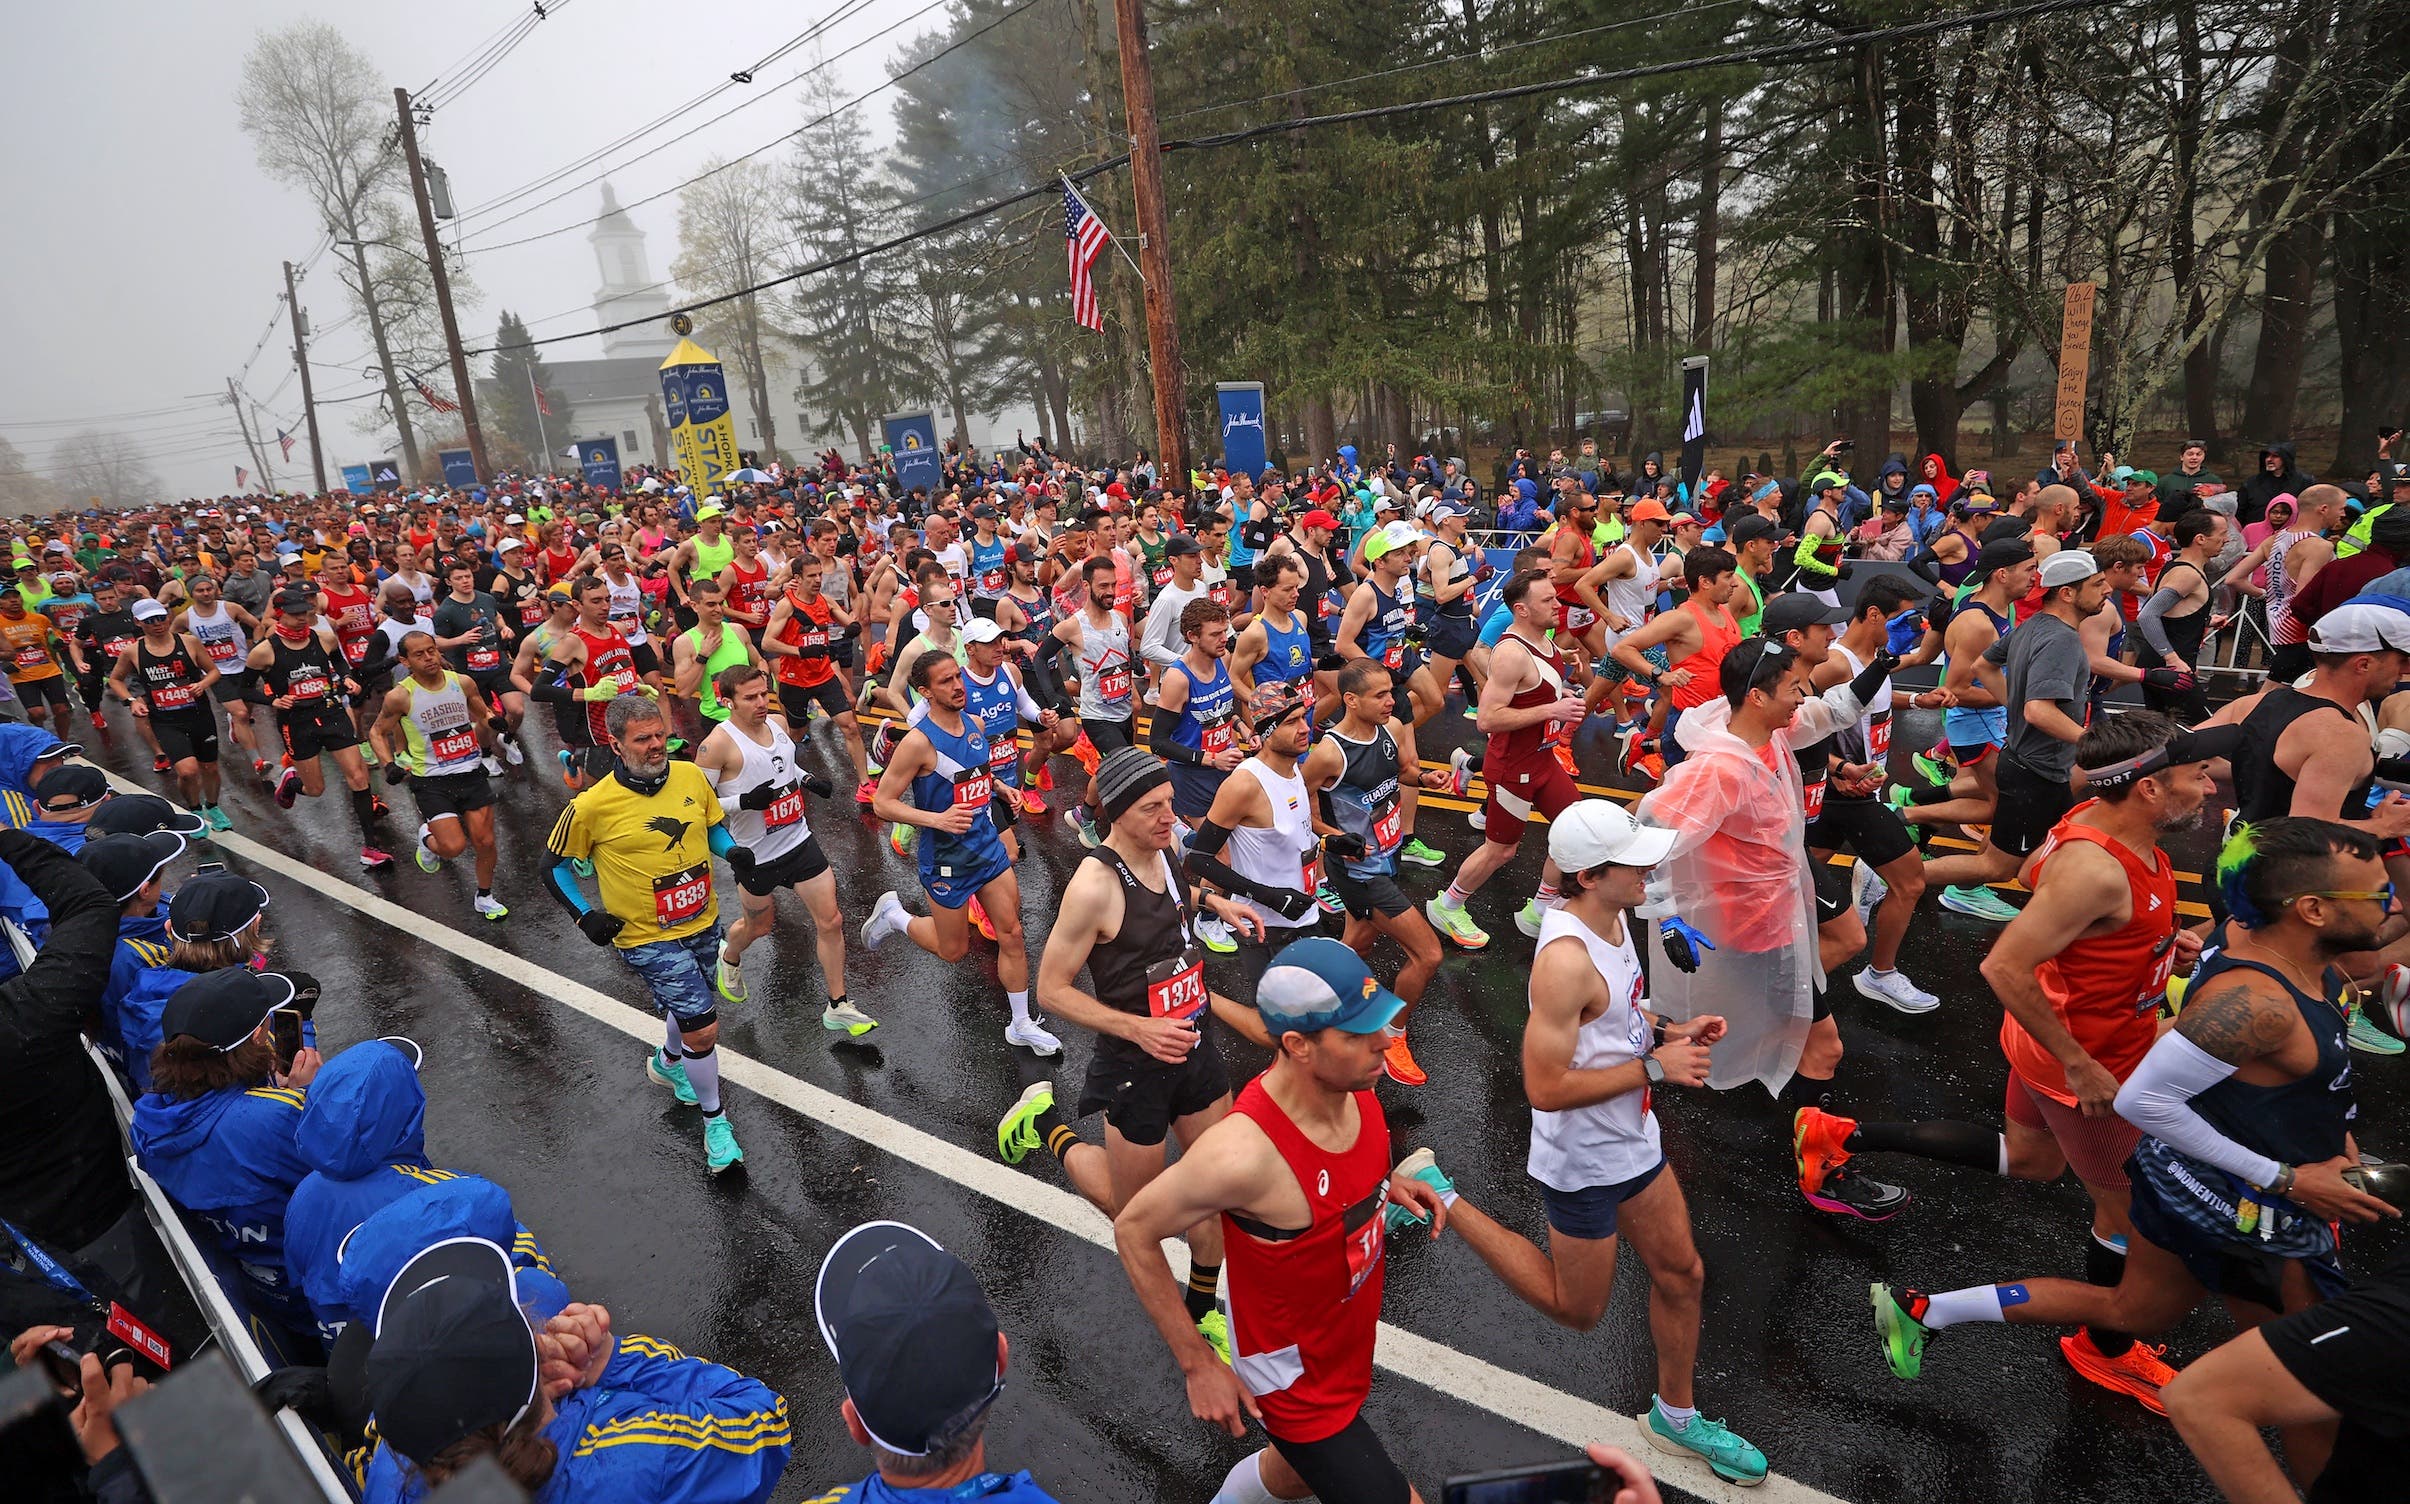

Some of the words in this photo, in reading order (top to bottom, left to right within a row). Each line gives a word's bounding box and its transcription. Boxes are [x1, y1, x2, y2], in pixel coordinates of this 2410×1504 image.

[2068, 285, 2092, 303] 26.2
[2067, 303, 2085, 316] will
[2062, 361, 2083, 381] Enjoy
[2063, 381, 2078, 393] the
[145, 664, 170, 676] WEST
[148, 670, 176, 682] VALLEY
[980, 701, 1012, 720] Agos
[430, 713, 465, 730] STRIDERS
[437, 734, 474, 755] 1649
[1206, 727, 1231, 748] 1202
[960, 778, 991, 803] 1229
[769, 794, 802, 822] 1678
[1115, 861, 1138, 888] soar
[662, 881, 707, 913] 1333
[1157, 970, 1200, 1013] 1373
